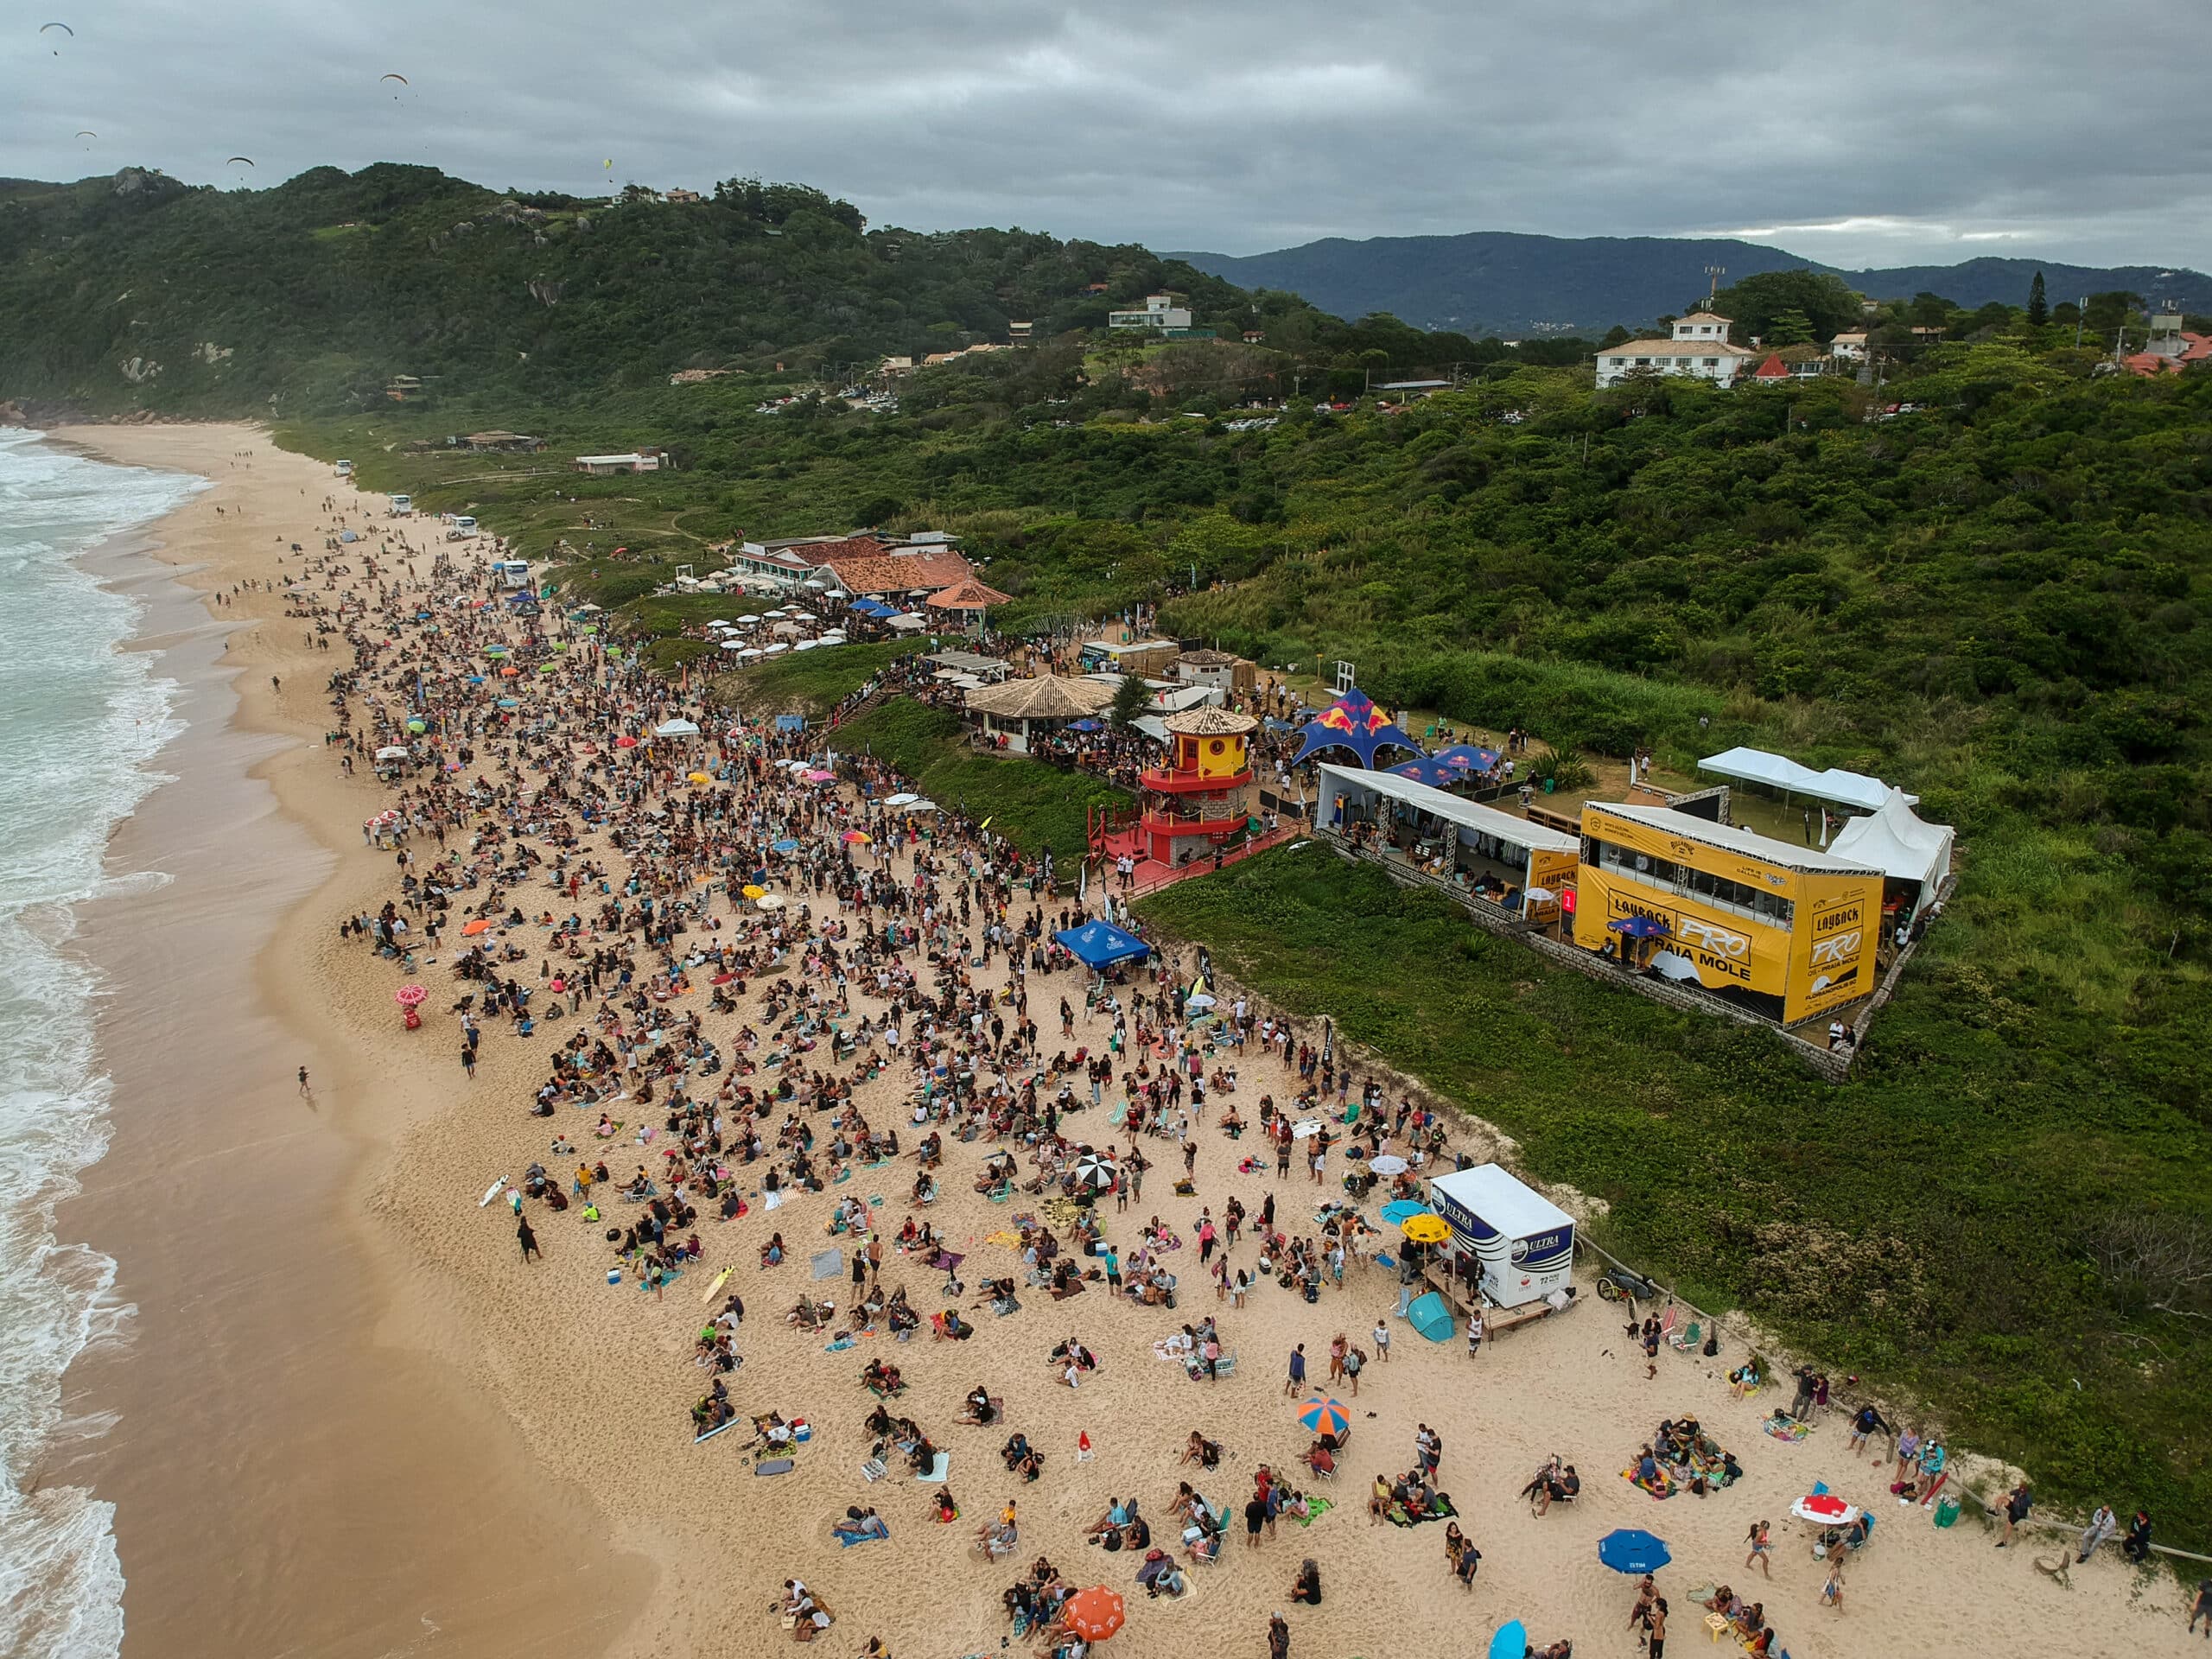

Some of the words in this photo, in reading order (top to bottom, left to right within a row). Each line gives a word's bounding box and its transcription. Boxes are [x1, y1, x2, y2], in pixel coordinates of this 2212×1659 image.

[1565, 896, 1571, 907] 1
[1816, 907, 1859, 931] LAYBACK
[1679, 917, 1747, 958] PRO
[1812, 931, 1860, 963] PRO
[1645, 935, 1694, 961] PRAIA
[1700, 952, 1751, 981] MOLE
[1821, 961, 1840, 972] PRAIA
[1841, 954, 1860, 965] MOLE
[1446, 1202, 1472, 1229] ULTRA
[1529, 1235, 1559, 1250] ULTRA
